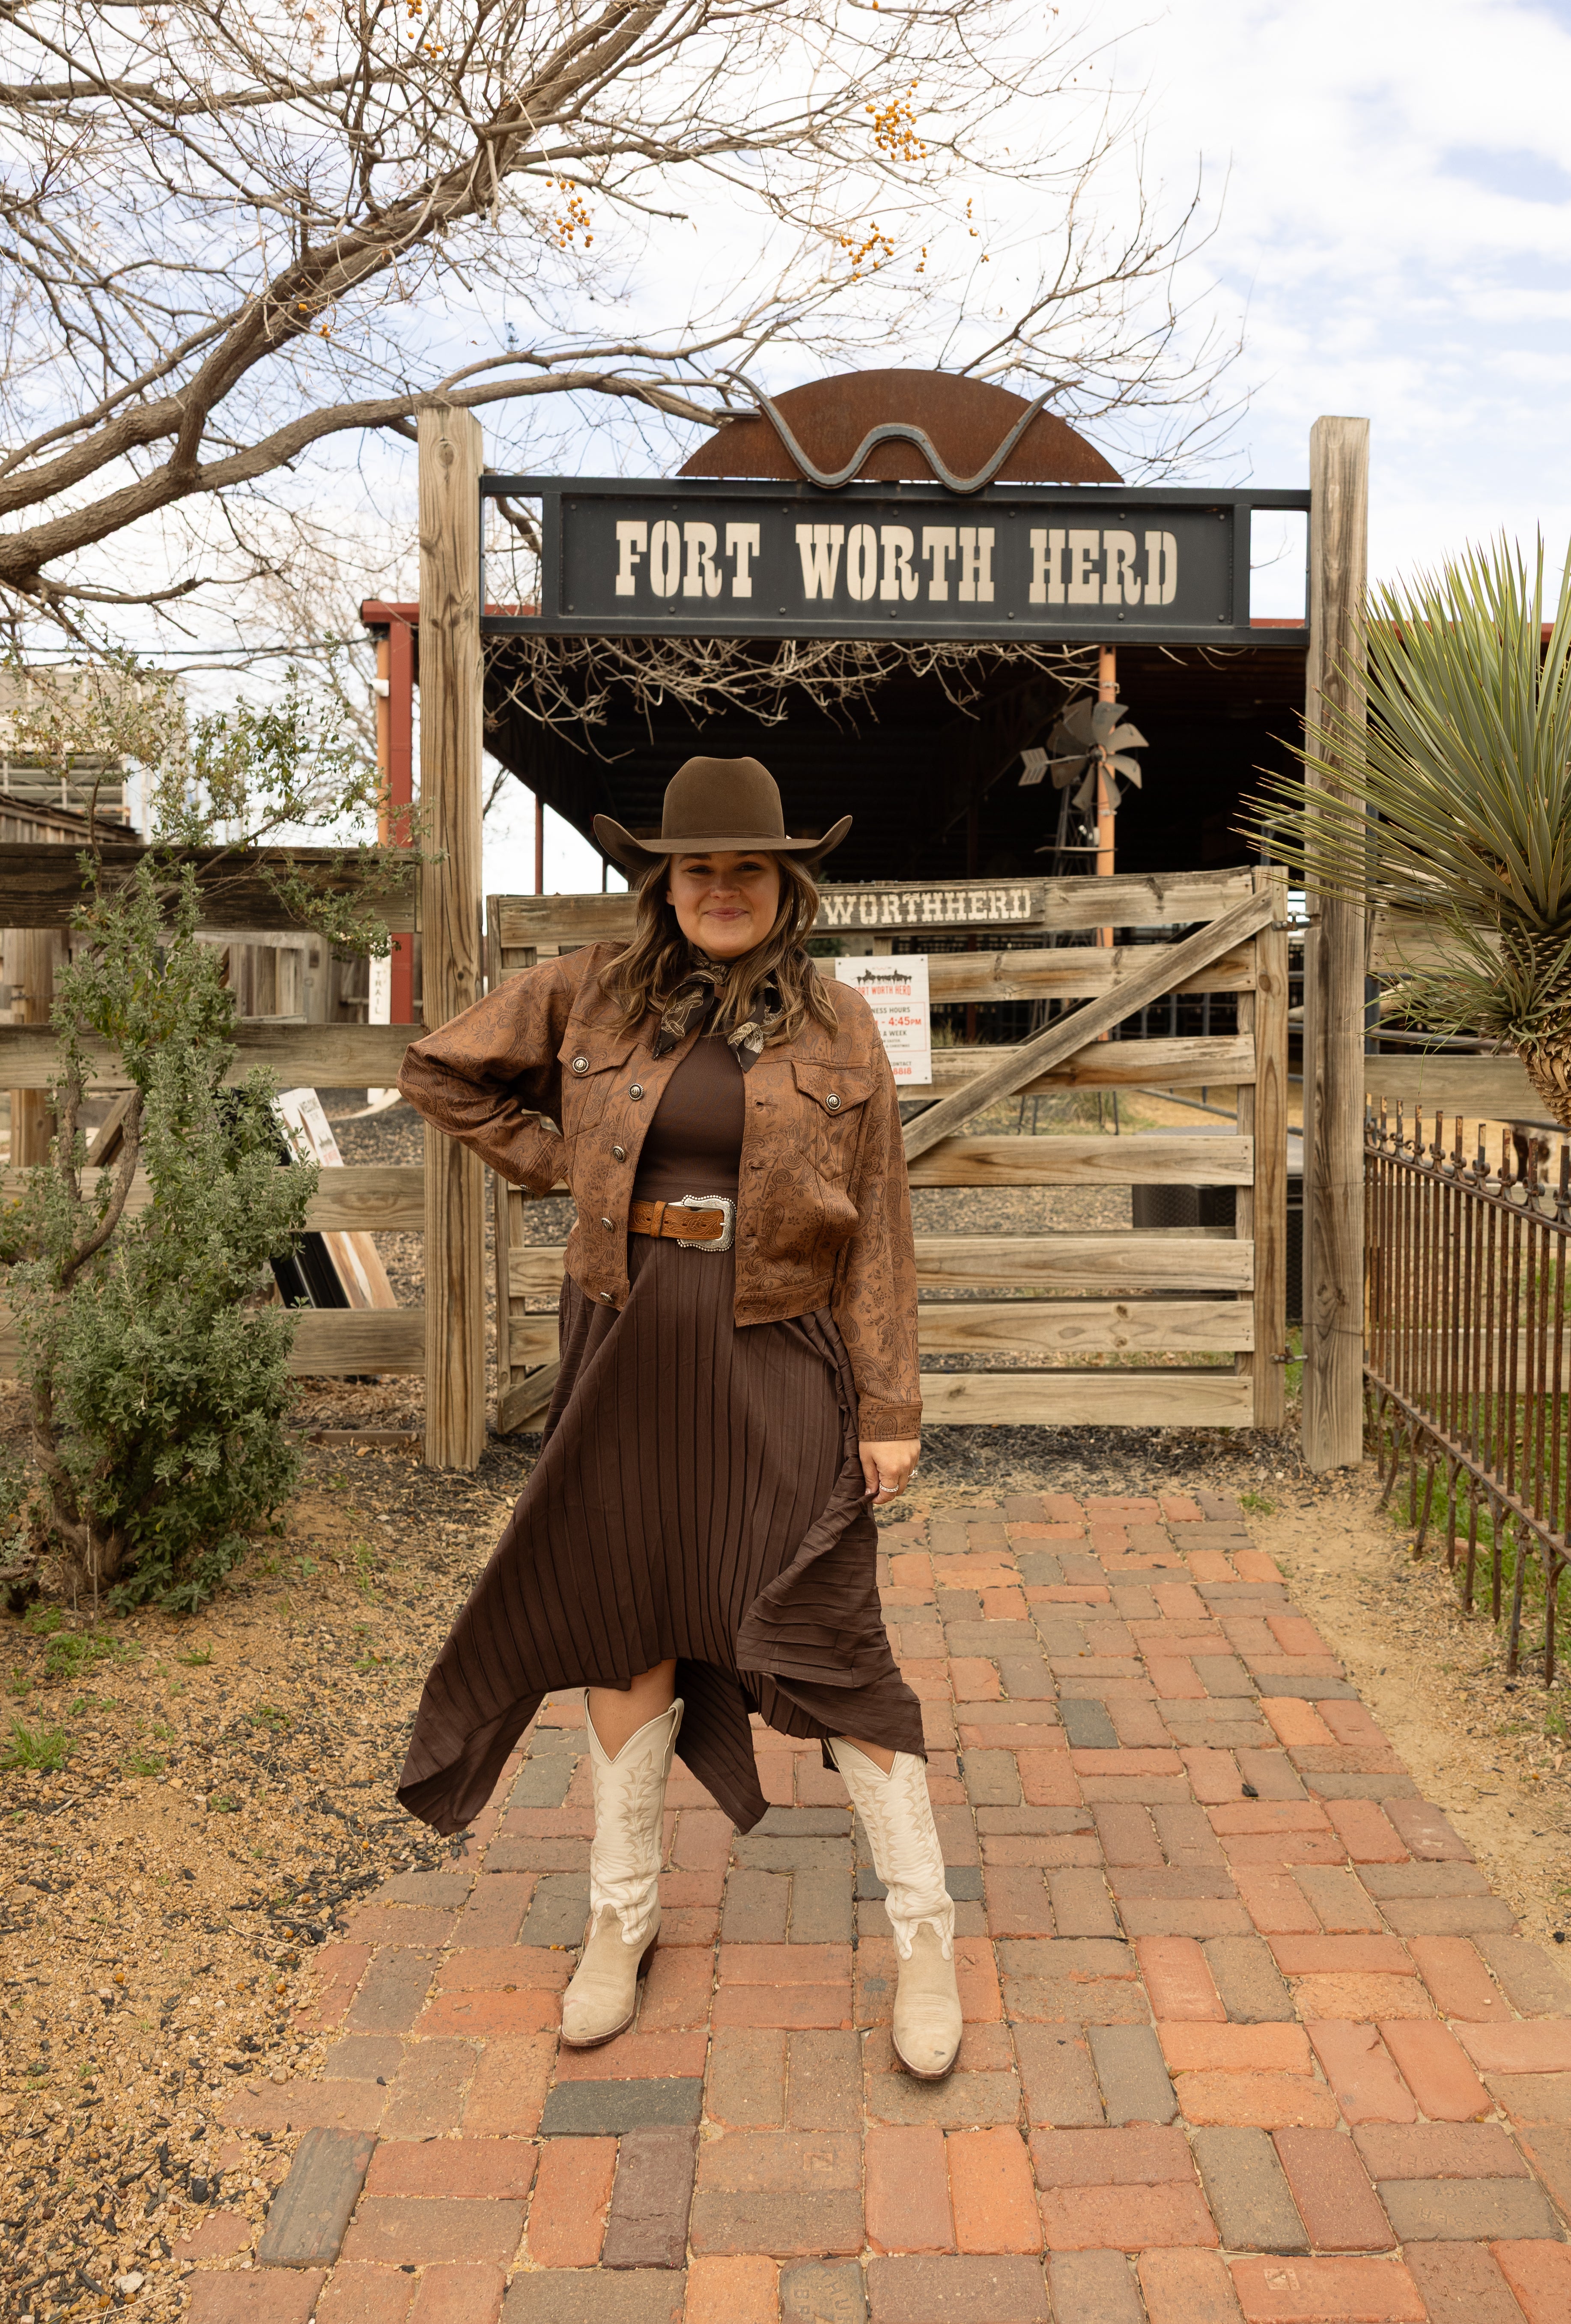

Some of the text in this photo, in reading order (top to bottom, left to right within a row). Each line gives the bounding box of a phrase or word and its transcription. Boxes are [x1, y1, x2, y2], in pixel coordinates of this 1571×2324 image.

[615, 519, 1178, 606] FORT WORTH HERD
[872, 986, 893, 995] WORTH
[895, 985, 911, 996] HERD
[888, 1016, 921, 1026] 4:45PM
[1078, 1880, 1103, 1923] THURBER
[1397, 2127, 1458, 2141] BRICK
